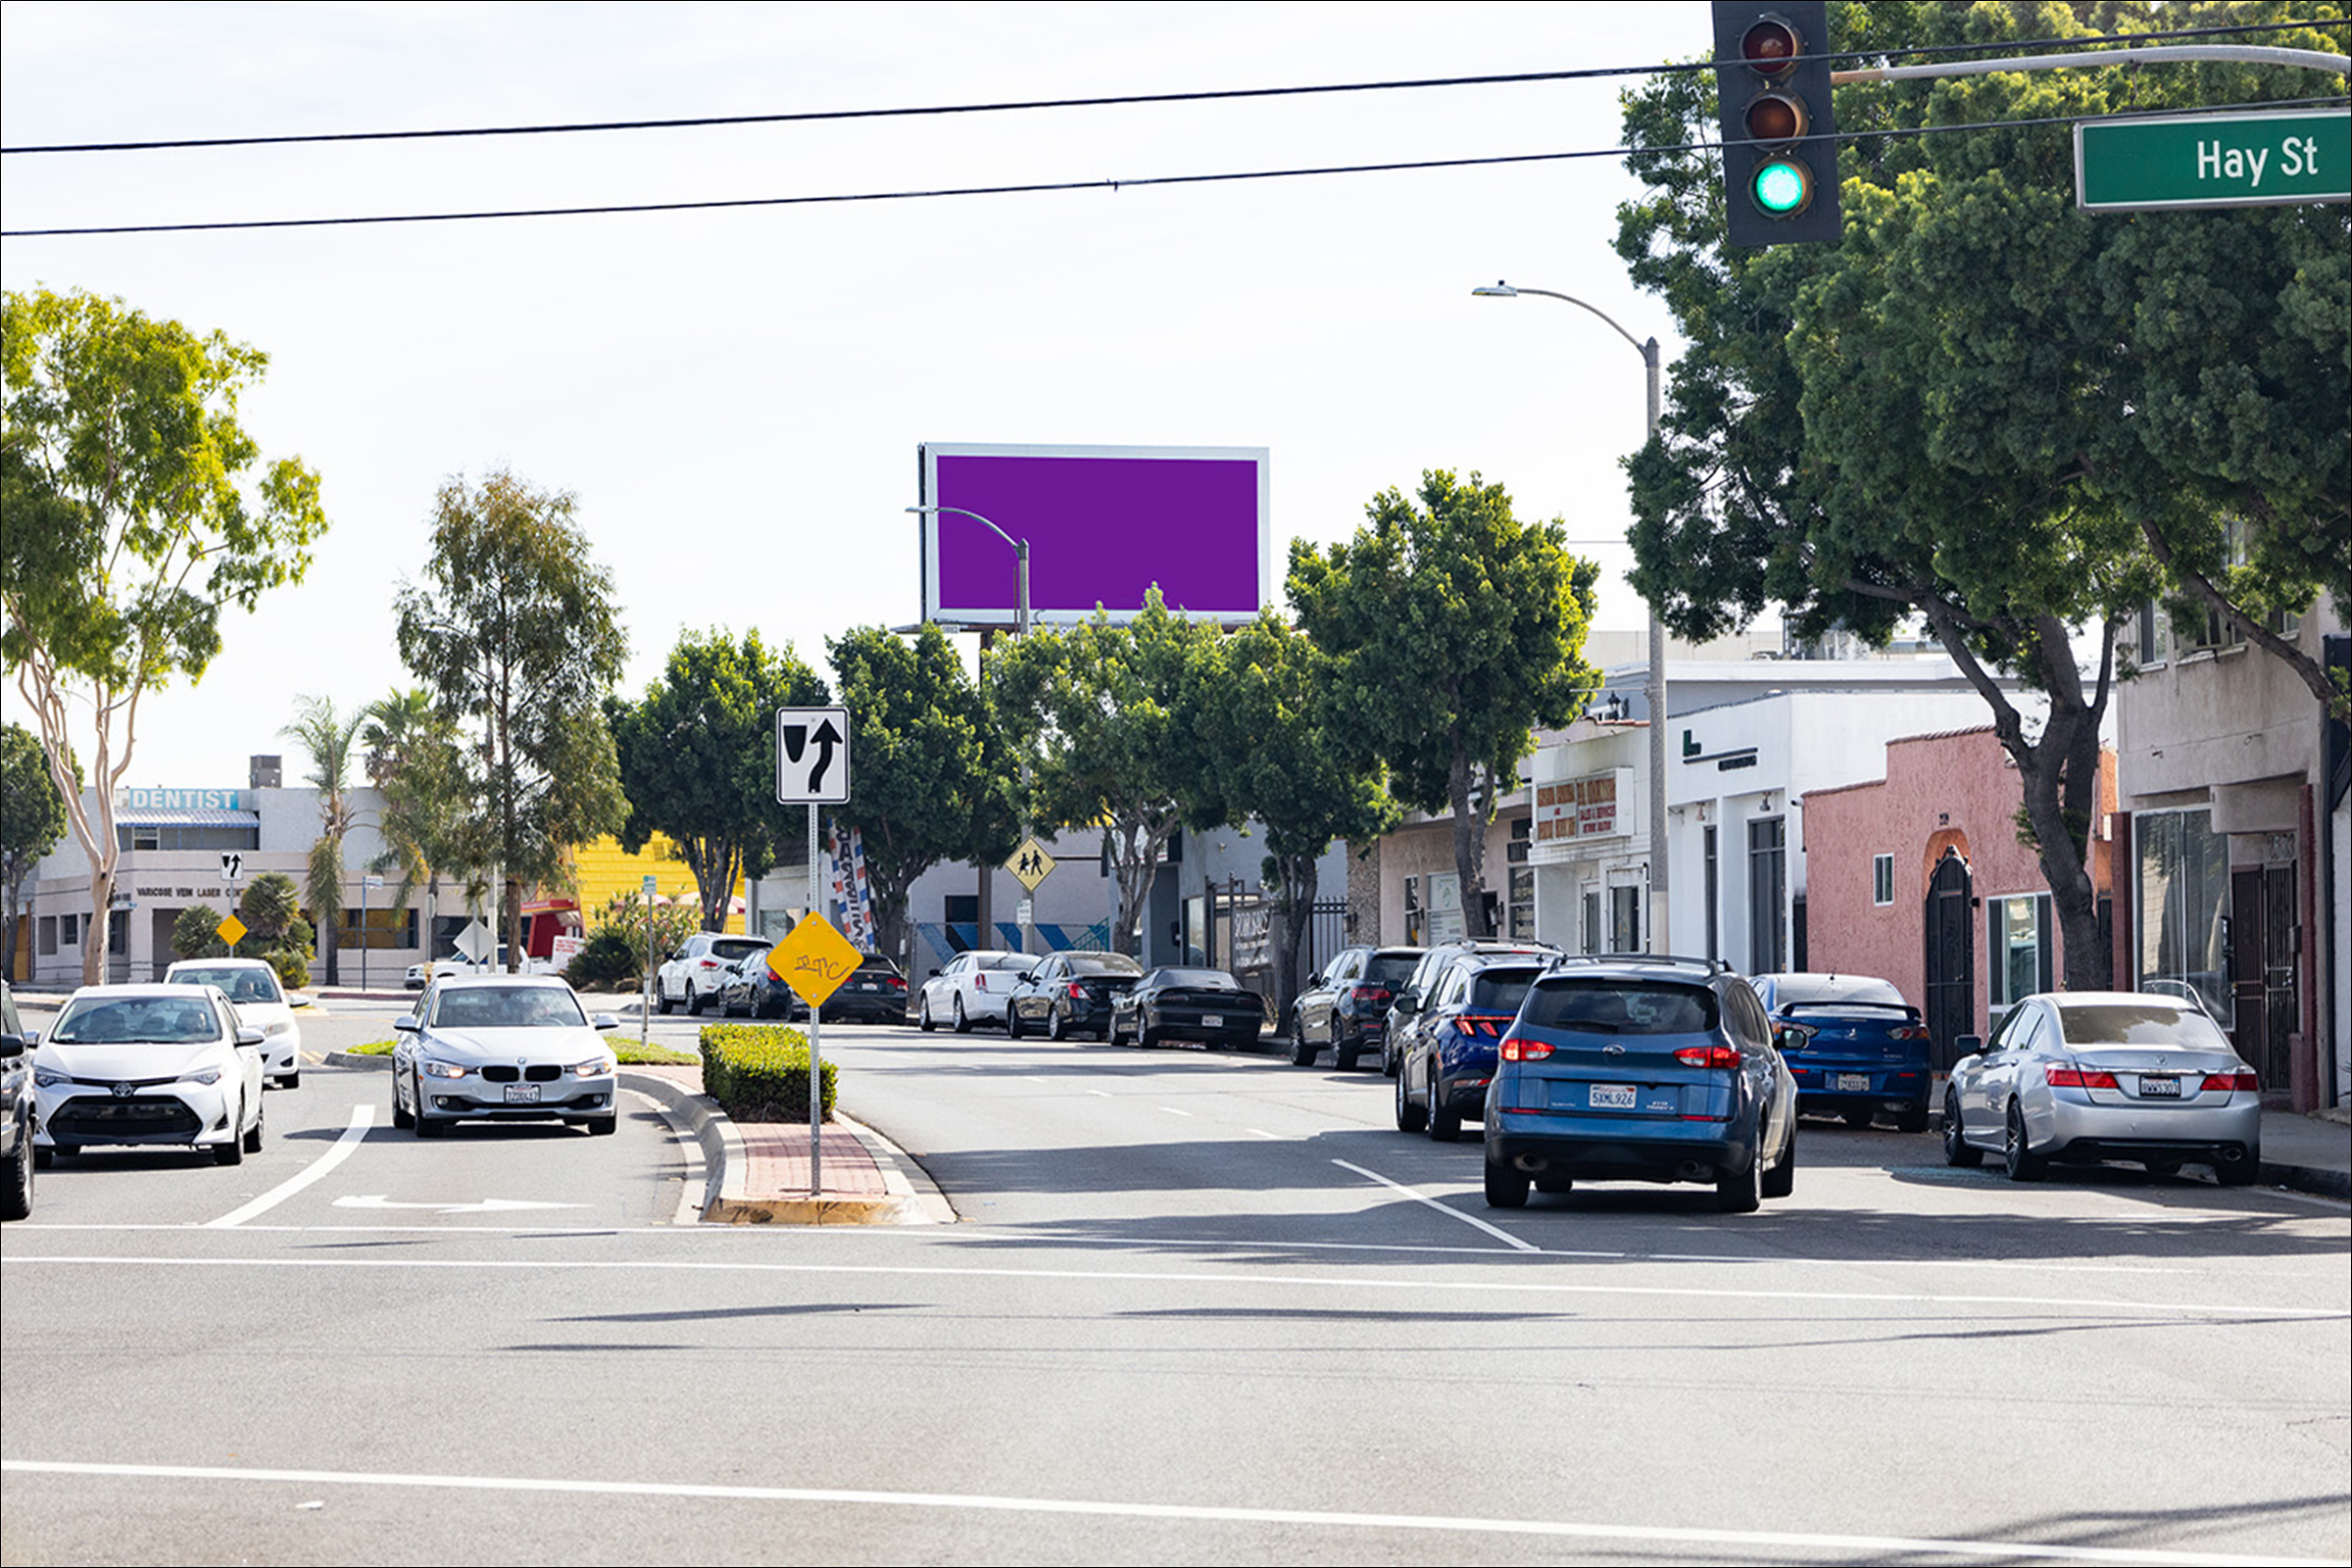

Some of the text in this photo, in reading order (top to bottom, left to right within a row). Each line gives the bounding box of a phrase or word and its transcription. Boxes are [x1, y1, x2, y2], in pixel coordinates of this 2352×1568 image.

[2197, 136, 2319, 187] Hay St
[132, 790, 235, 808] DENTIST
[136, 887, 172, 898] VARICOSE
[176, 887, 193, 898] VEIN
[197, 887, 220, 898] LASER
[1592, 1093, 1634, 1104] 5XML926
